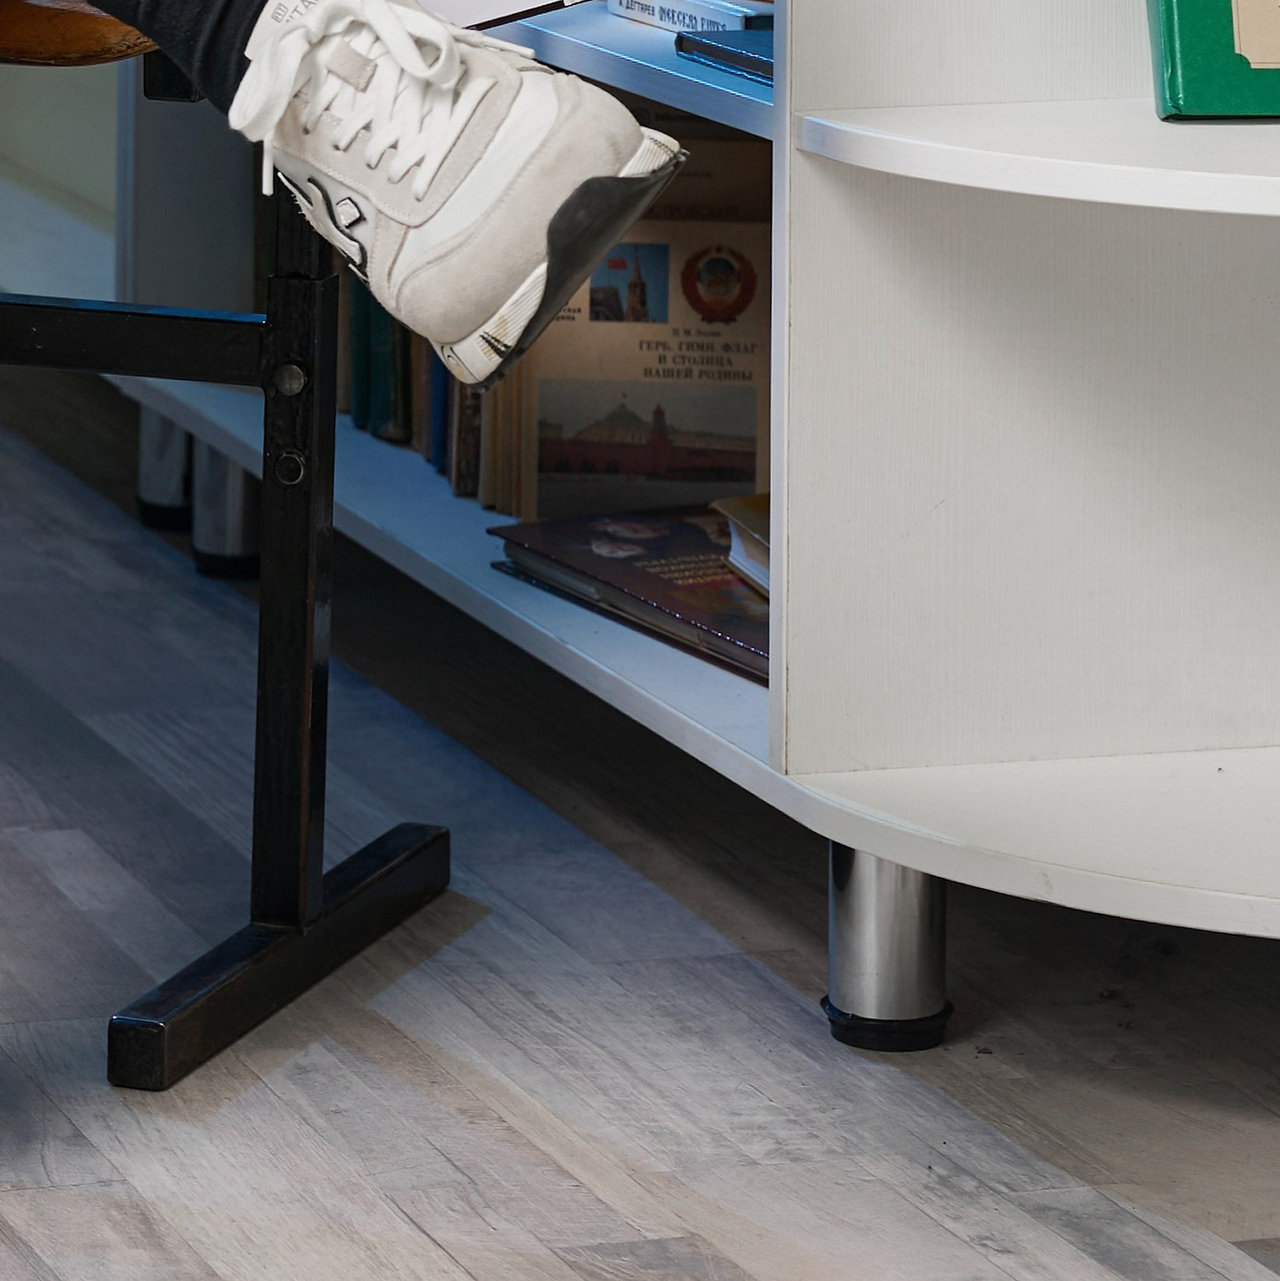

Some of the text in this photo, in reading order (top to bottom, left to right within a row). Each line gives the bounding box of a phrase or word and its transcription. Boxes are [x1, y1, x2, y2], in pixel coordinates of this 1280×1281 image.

[625, 0, 656, 17] ДЕГТЯРЕВ
[720, 342, 758, 354] ФЛАГ
[672, 355, 734, 368] СТОЛИЦА
[643, 367, 754, 381] НАШЕЙ РОДИНЫ
